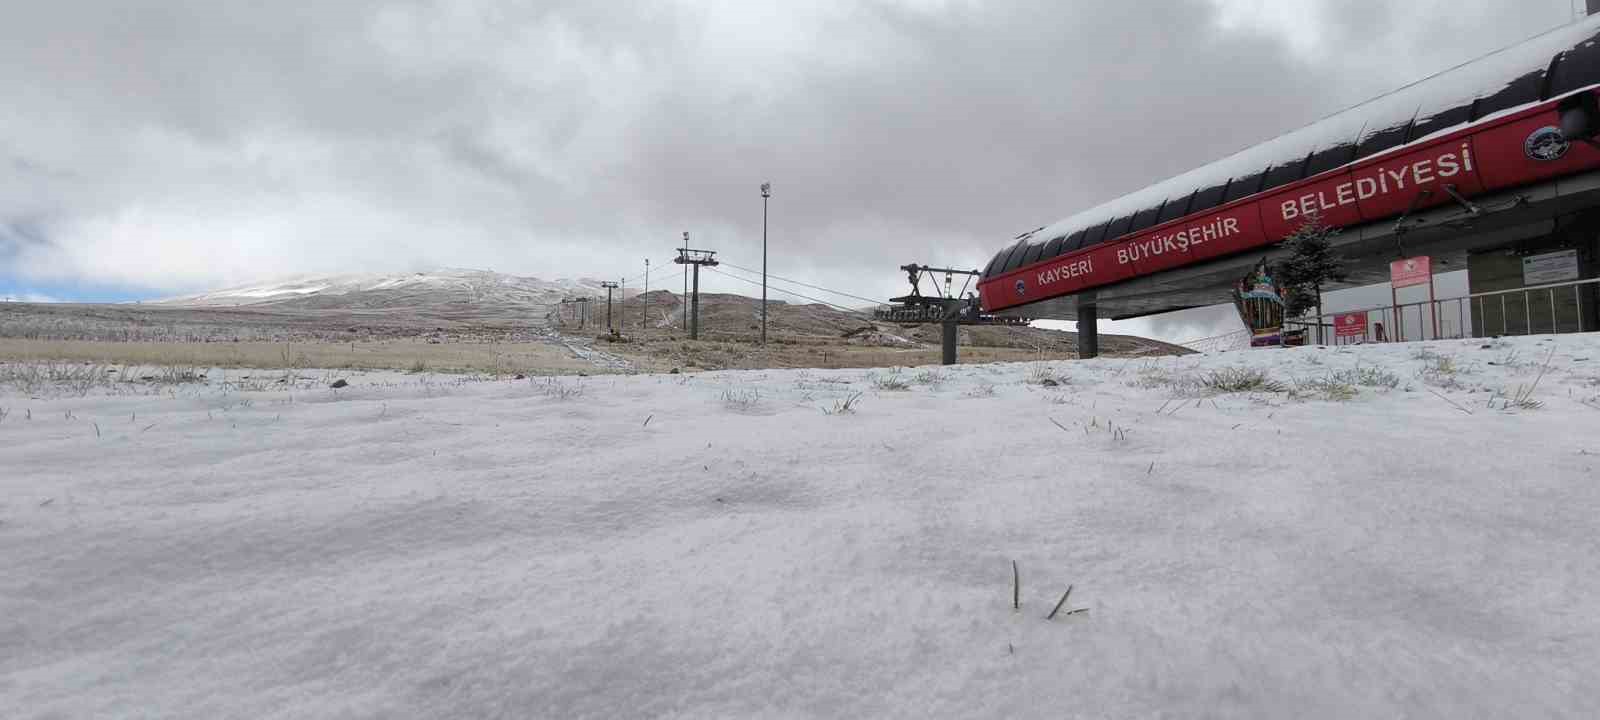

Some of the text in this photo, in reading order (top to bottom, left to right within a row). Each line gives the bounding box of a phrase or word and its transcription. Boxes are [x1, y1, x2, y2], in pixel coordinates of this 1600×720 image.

[1038, 255, 1093, 286] KAYSERİ
[1117, 217, 1240, 265] BÜYÜKŞEHİR
[1281, 143, 1473, 220] BELEDİYESİ
